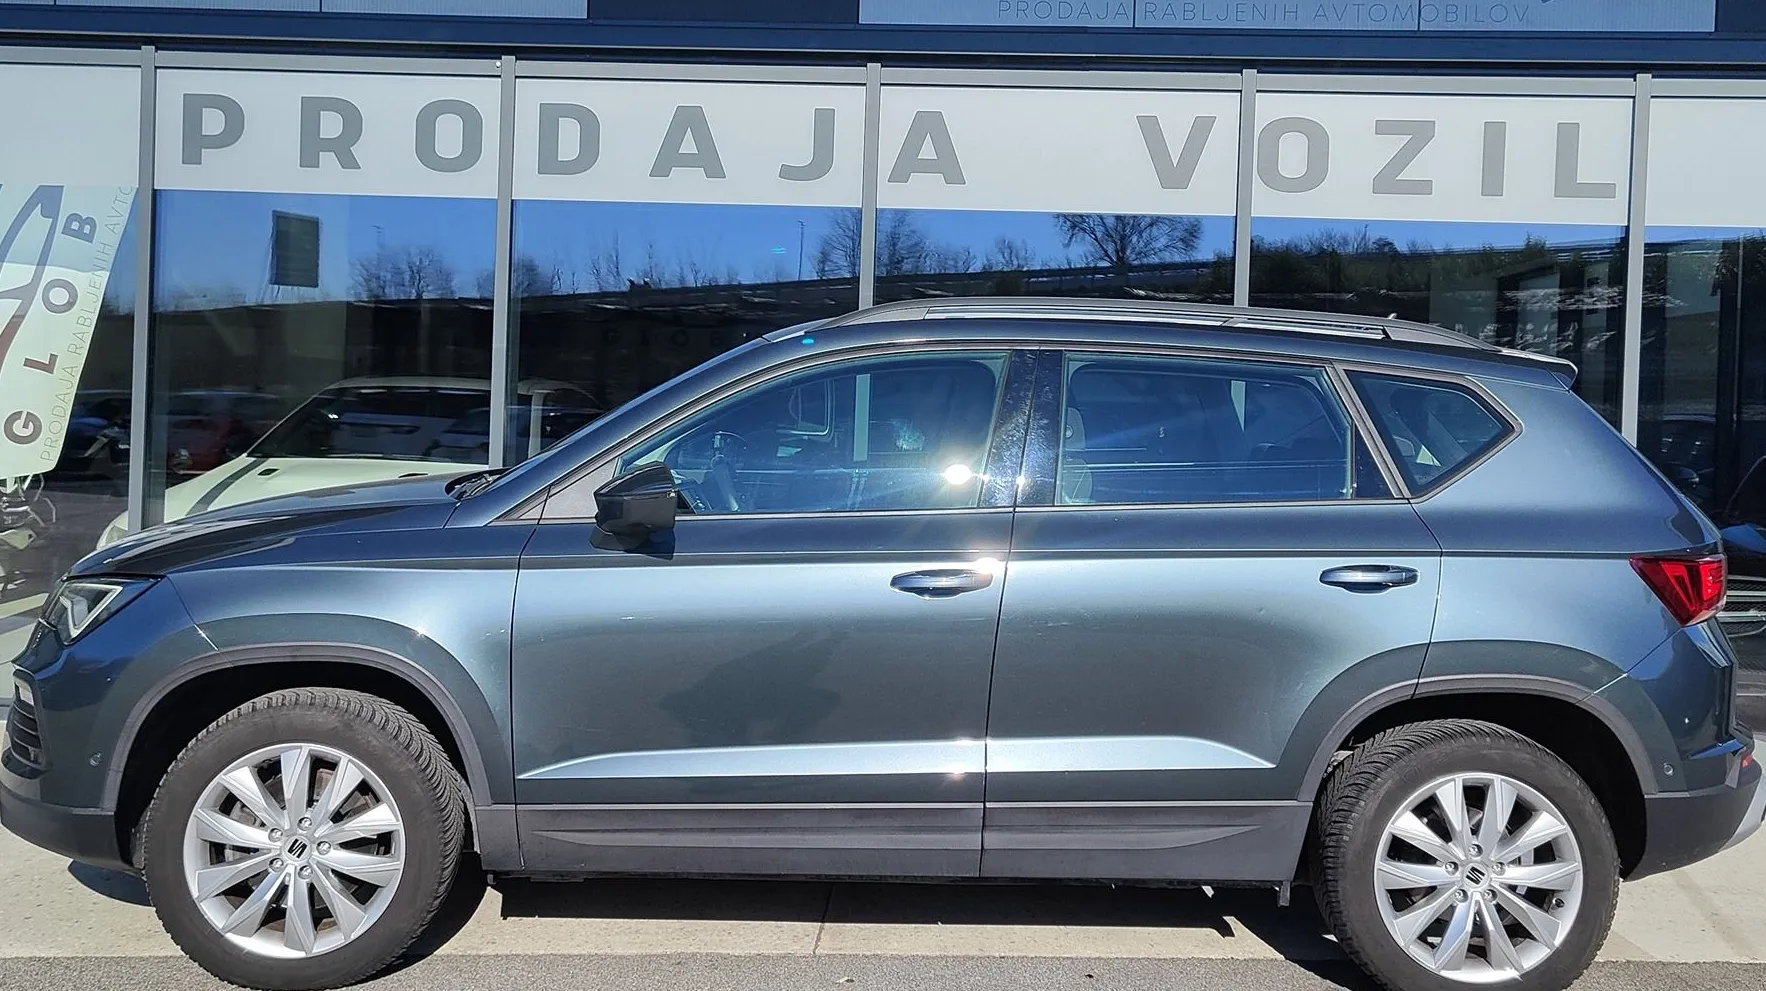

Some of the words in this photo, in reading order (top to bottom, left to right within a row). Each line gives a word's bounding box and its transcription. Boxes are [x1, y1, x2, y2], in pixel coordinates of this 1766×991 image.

[998, 0, 1130, 21] PRODAJA
[1144, 1, 1299, 23] RABLJENIH
[1312, 2, 1529, 25] AVTOMOBILOV
[181, 93, 966, 185] PRODAJA
[1136, 116, 1617, 199] VOZIL
[3, 212, 98, 445] GLOB
[40, 364, 79, 461] PRODAJA
[66, 241, 112, 356] RABLJENIH
